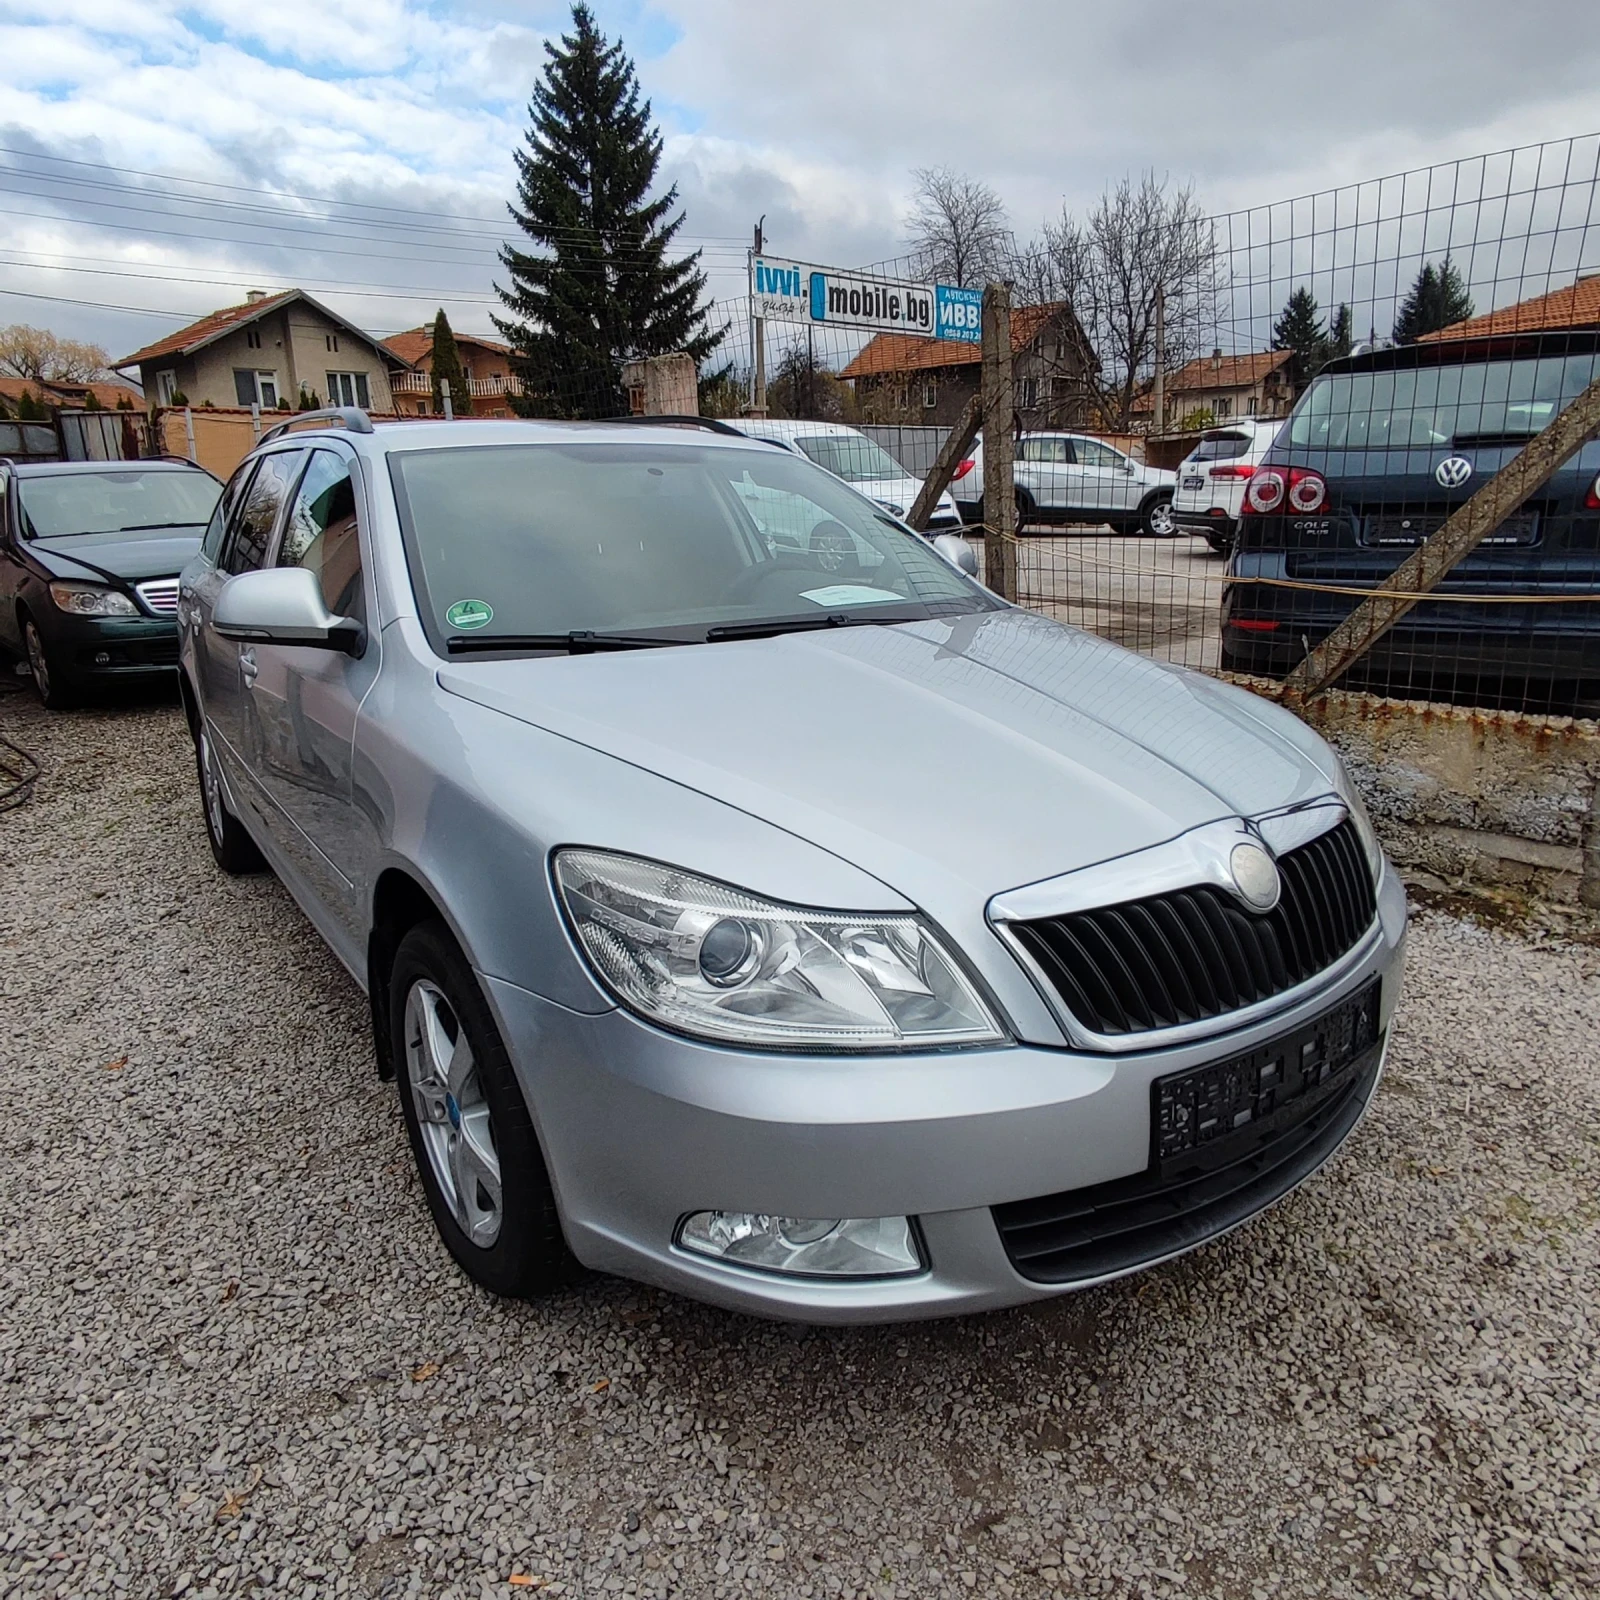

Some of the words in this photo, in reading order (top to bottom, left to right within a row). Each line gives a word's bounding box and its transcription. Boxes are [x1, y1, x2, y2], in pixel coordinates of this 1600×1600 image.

[828, 285, 930, 328] mobile.bg
[940, 301, 981, 329] ИВВ
[1293, 521, 1330, 530] GOLF
